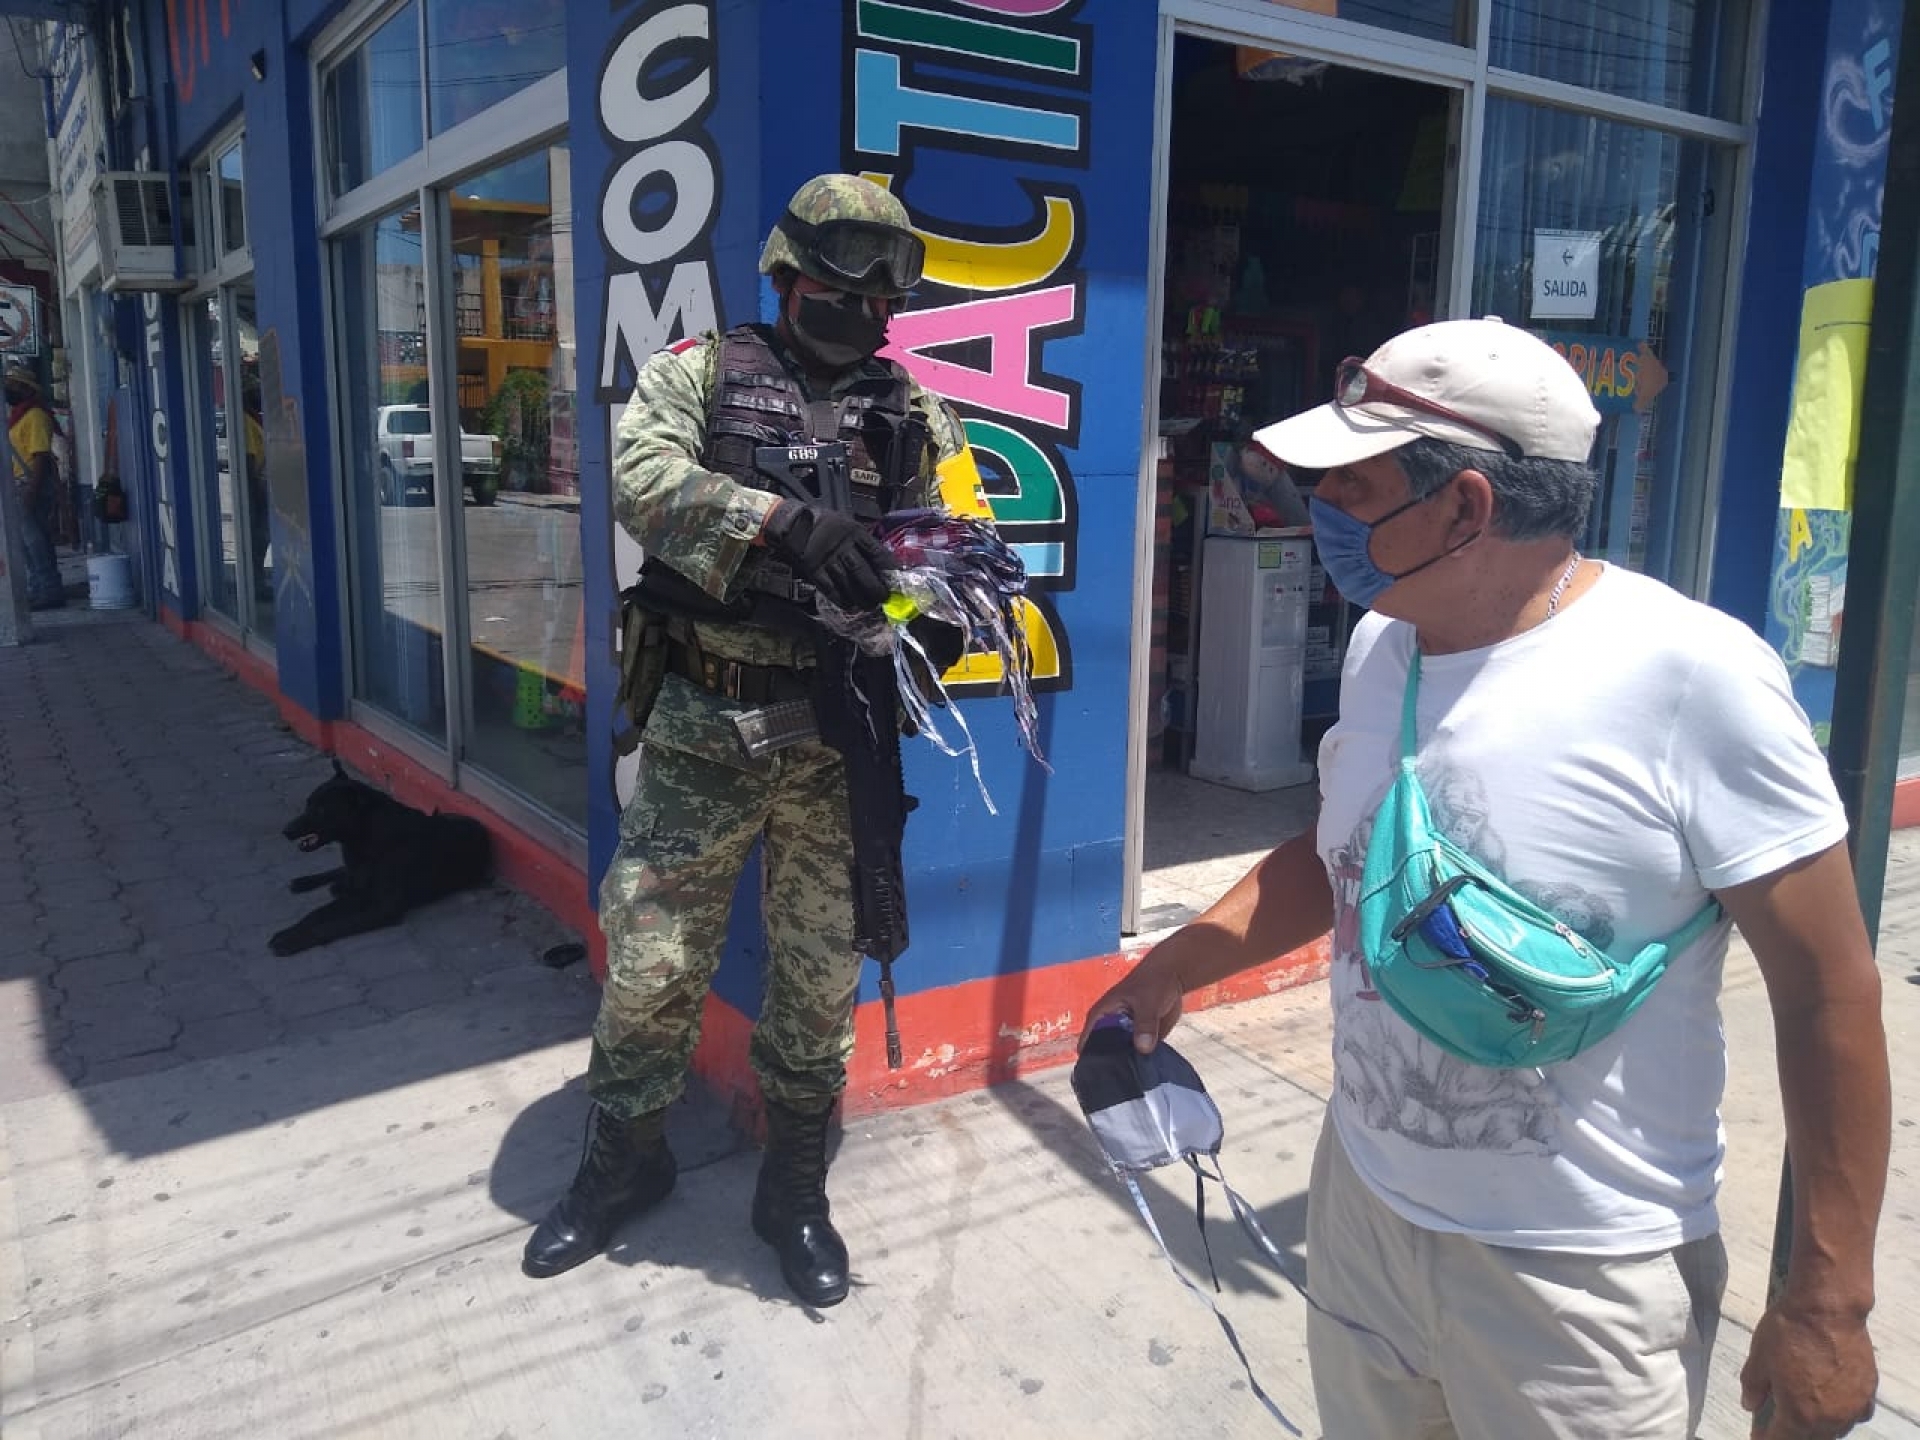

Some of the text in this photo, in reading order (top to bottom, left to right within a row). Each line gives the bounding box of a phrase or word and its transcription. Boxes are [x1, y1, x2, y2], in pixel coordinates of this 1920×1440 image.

[1543, 279, 1588, 297] SALIDA
[856, 0, 1081, 687] DACTI
[1553, 342, 1637, 397] PIAS
